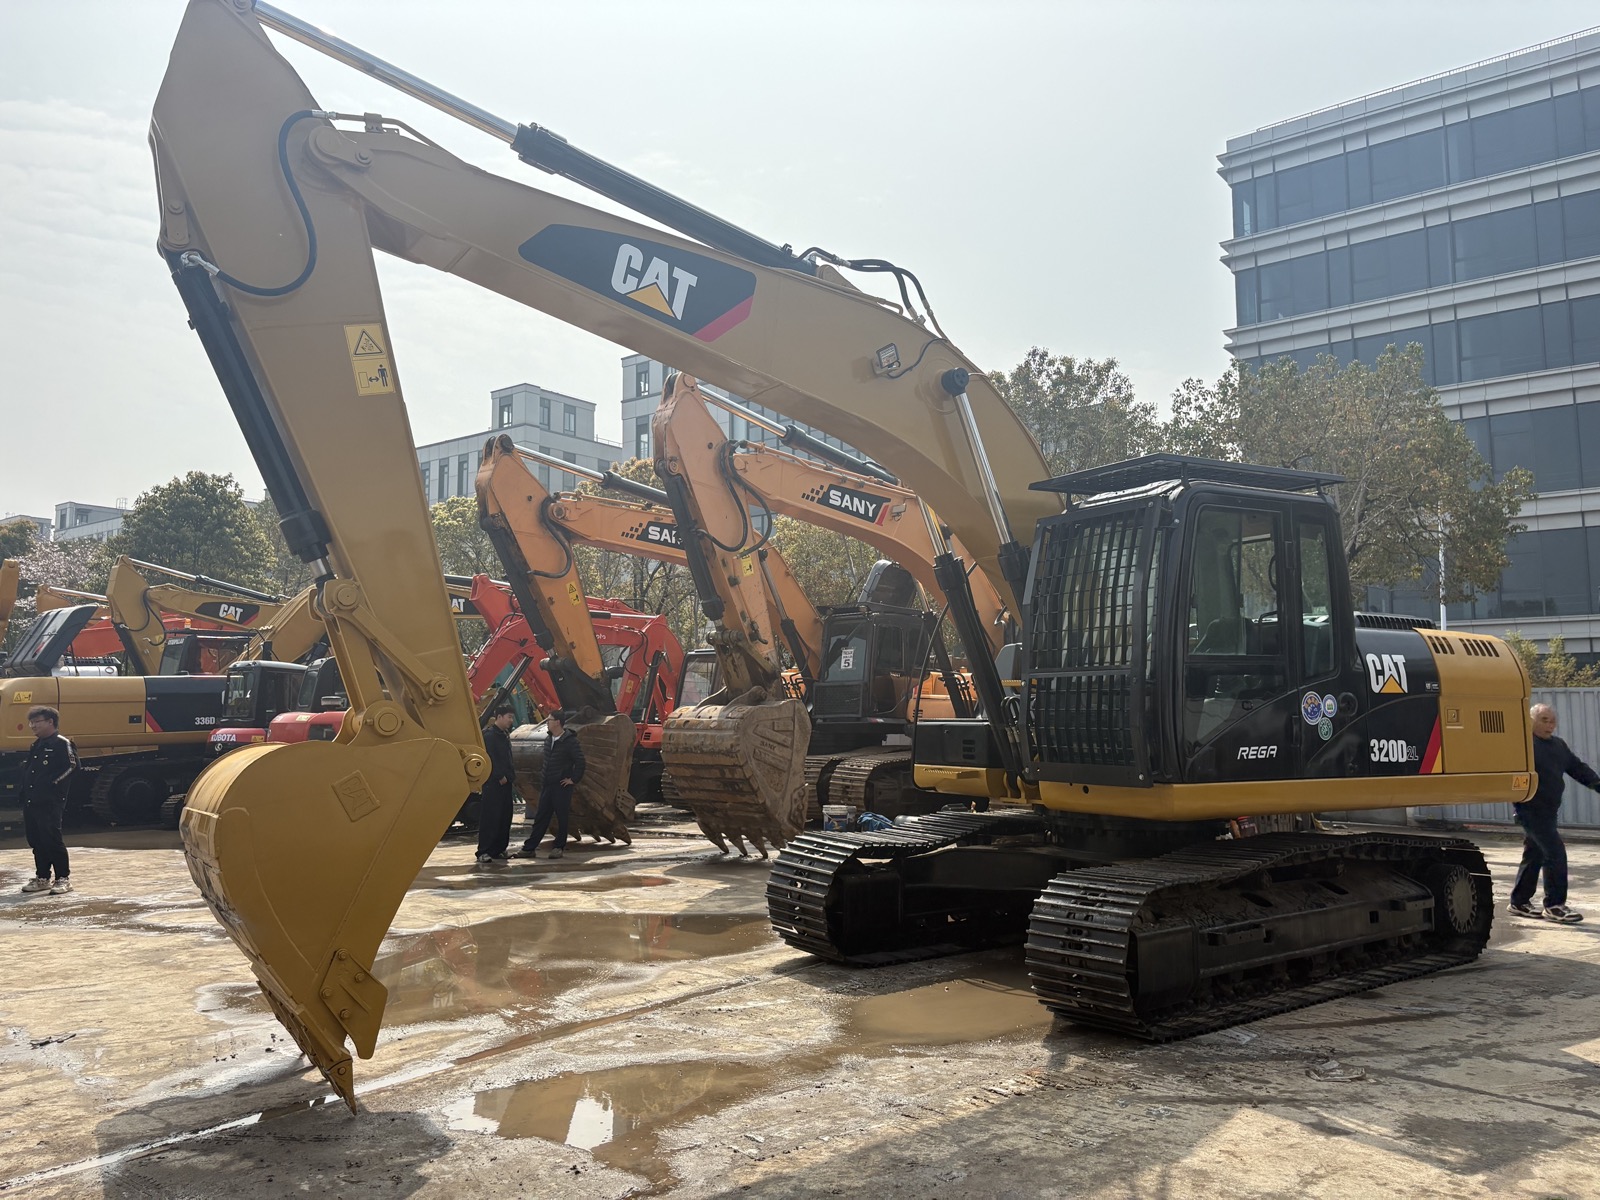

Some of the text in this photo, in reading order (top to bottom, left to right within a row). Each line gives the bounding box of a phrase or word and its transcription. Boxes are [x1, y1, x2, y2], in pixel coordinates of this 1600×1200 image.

[611, 243, 698, 321] CAT
[829, 489, 877, 518] SANY
[219, 603, 244, 622] CAT
[450, 598, 466, 613] AT
[842, 658, 851, 668] 5
[1365, 653, 1408, 694] CAT
[194, 716, 216, 725] 336D
[1237, 745, 1278, 760] REGA
[1369, 738, 1419, 763] 320D2L
